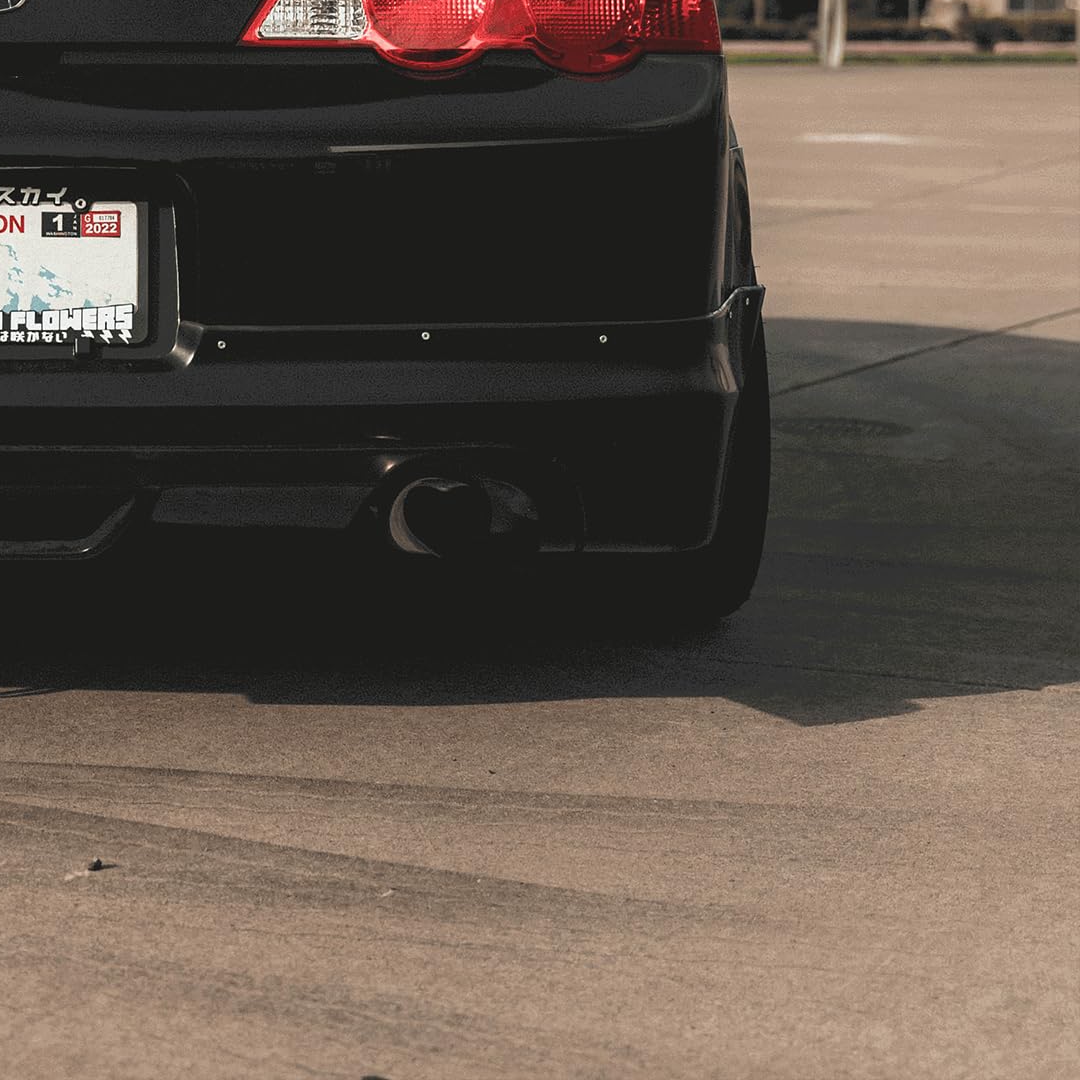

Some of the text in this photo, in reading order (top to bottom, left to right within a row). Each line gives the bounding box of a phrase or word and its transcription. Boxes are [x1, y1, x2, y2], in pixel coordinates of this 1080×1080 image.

[52, 213, 64, 232] 1
[85, 223, 118, 234] 2022
[10, 304, 134, 331] FLOWERS
